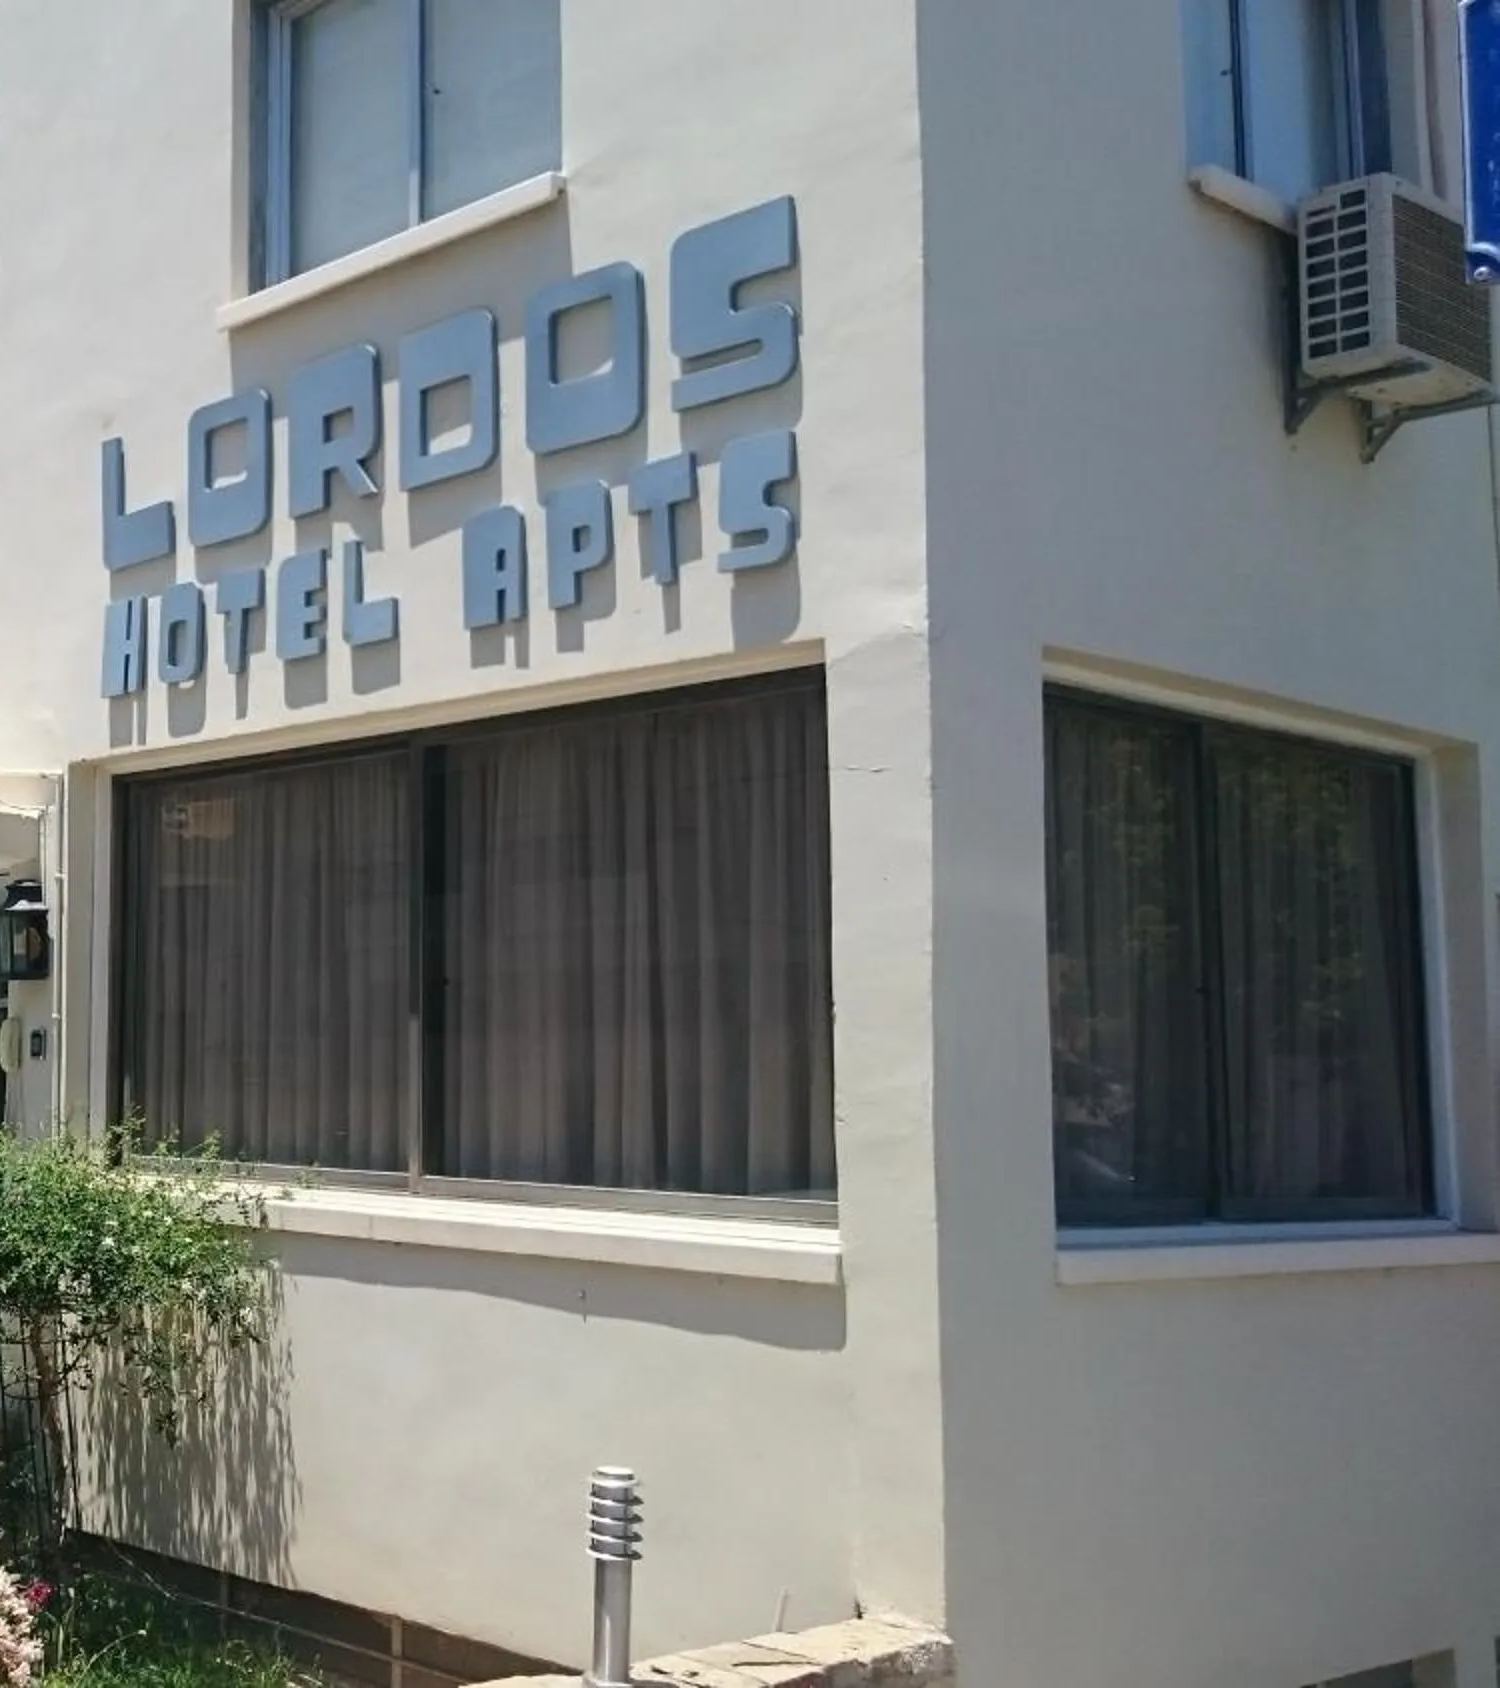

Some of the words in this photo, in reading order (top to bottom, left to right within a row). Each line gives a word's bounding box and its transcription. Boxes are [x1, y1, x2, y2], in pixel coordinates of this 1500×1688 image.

[101, 195, 799, 572] LORDOS
[101, 538, 399, 699] HOTEL
[462, 430, 799, 631] APTS
